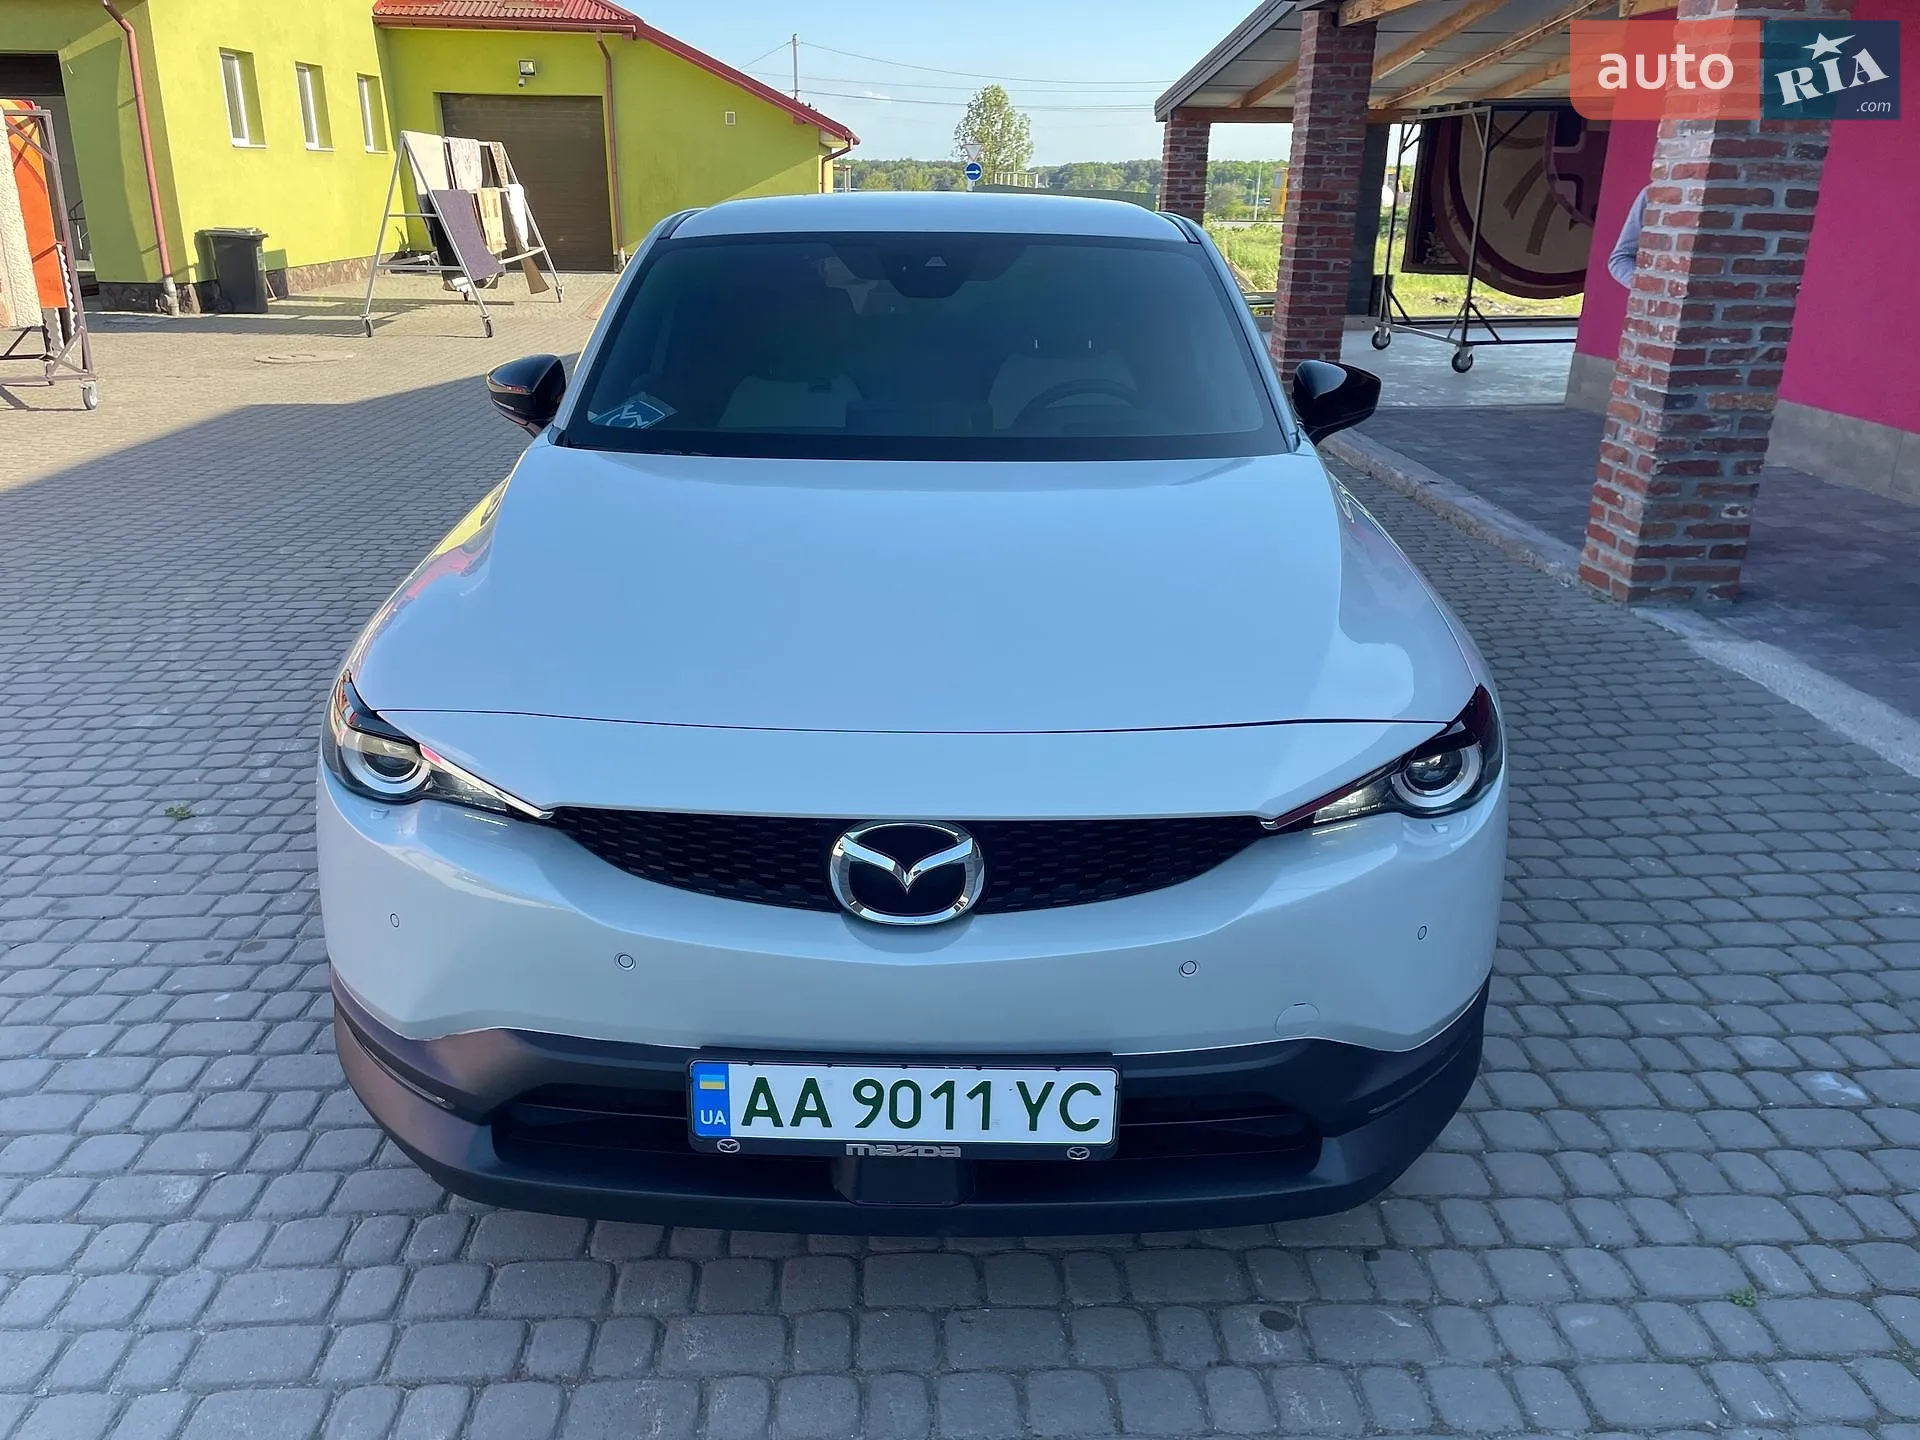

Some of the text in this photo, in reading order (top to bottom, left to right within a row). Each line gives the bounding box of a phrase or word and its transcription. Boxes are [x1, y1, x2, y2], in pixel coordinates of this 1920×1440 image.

[700, 1109, 727, 1126] UA
[741, 1076, 1102, 1132] AA 9011 YC
